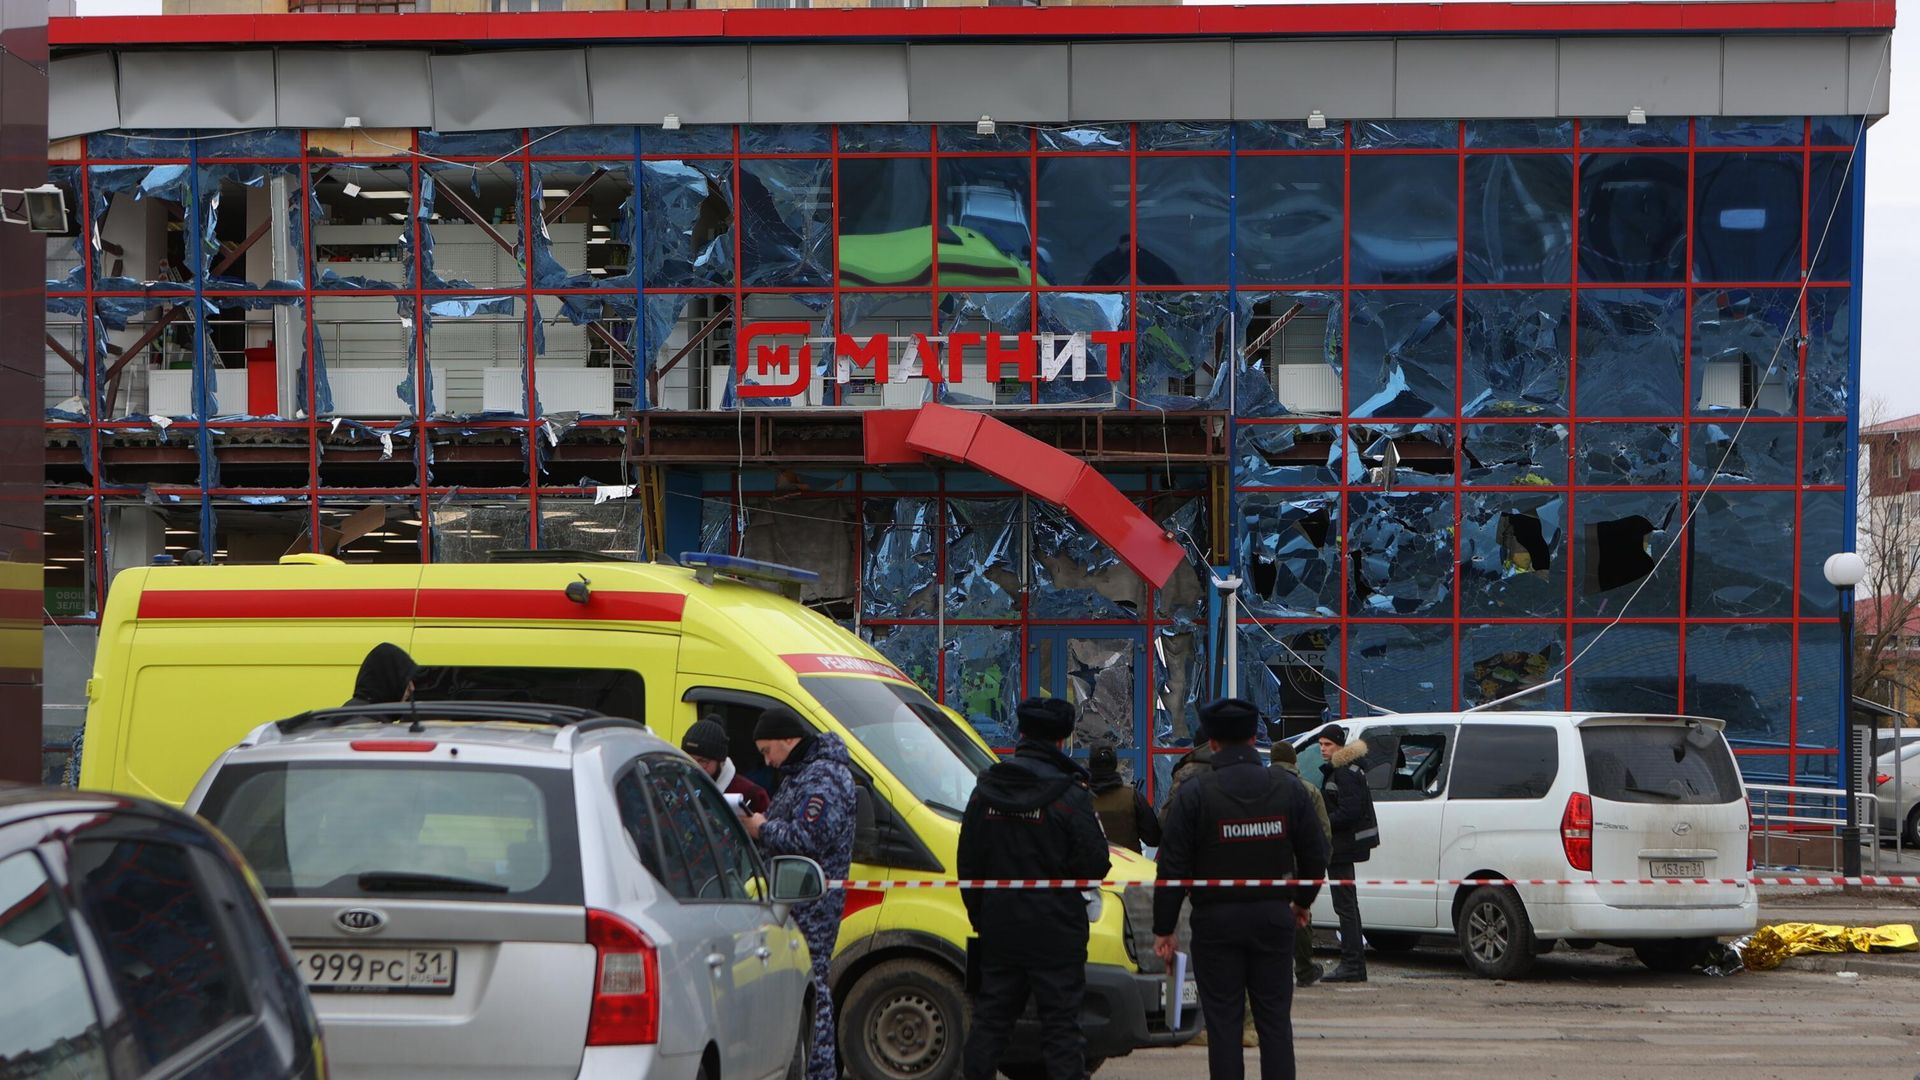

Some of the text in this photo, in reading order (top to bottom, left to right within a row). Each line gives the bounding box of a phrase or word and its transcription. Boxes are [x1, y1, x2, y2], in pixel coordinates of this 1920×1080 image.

[835, 330, 1136, 384] МАГНИТ
[1222, 820, 1283, 839] ПОЛИЦИЯ
[344, 913, 376, 927] KIA
[414, 951, 443, 975] 31
